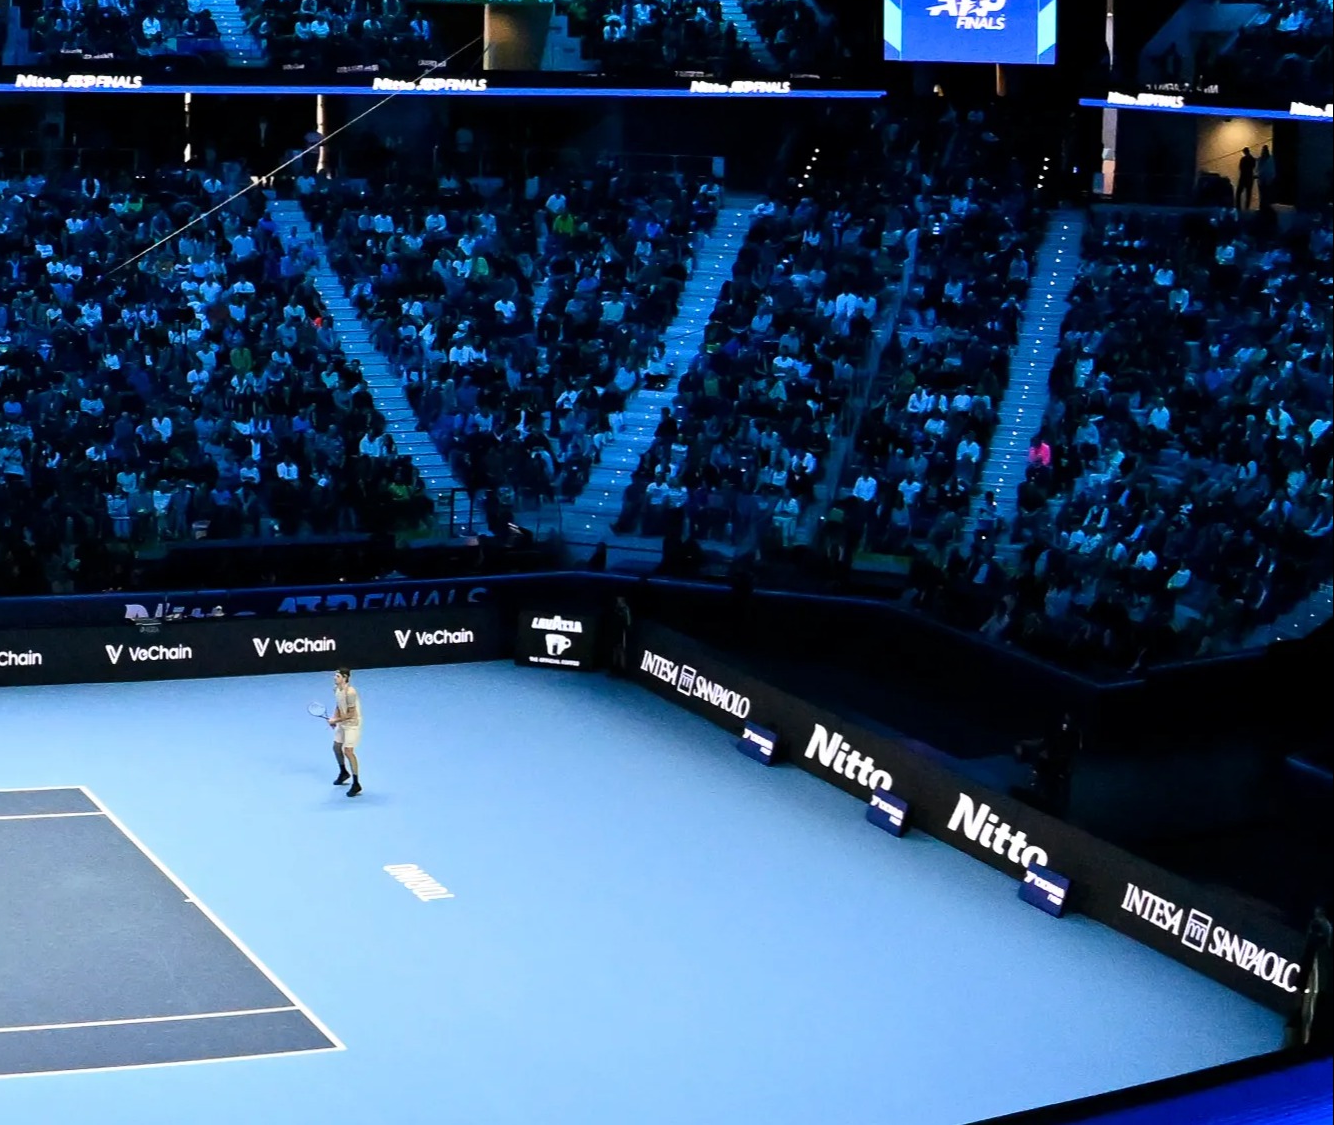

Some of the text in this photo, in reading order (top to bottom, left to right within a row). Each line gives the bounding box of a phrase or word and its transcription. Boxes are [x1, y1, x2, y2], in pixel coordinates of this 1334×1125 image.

[955, 15, 1007, 30] FINALS
[95, 75, 143, 89] FINALS
[274, 636, 336, 654] VeChain
[415, 628, 474, 646] VeChain
[128, 643, 193, 662] VeChain
[640, 649, 751, 719] INTESA SANPAOLO
[804, 723, 893, 791] Nitto
[946, 792, 1048, 868] Nitto
[1120, 882, 1184, 936] INTESA
